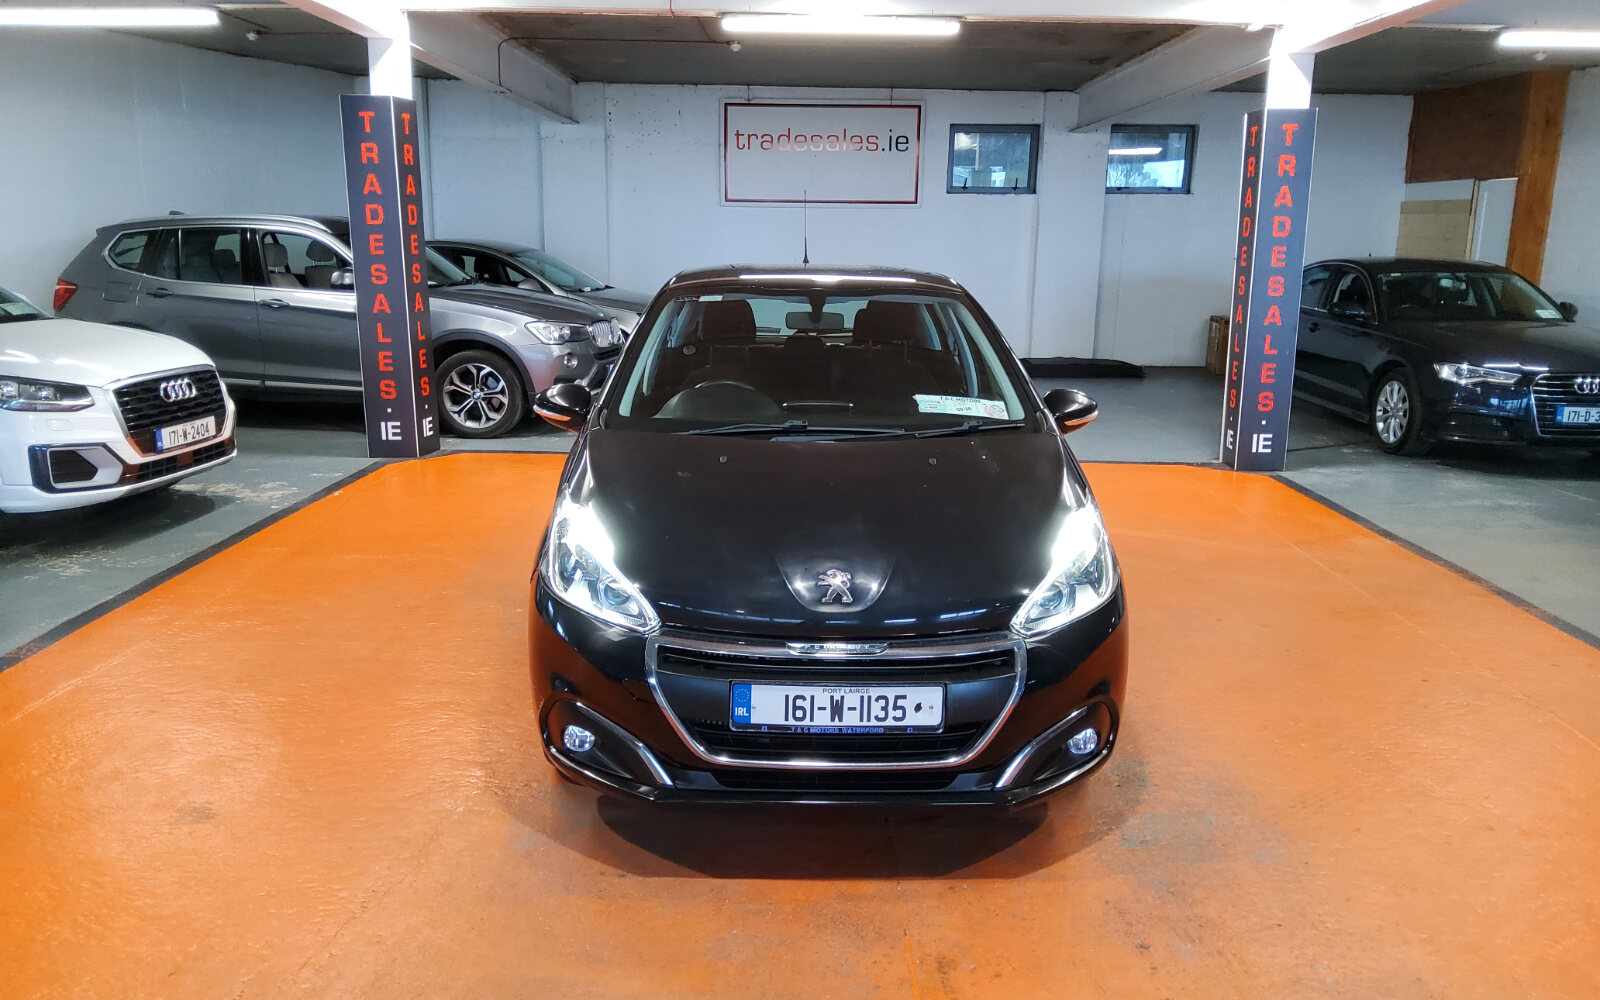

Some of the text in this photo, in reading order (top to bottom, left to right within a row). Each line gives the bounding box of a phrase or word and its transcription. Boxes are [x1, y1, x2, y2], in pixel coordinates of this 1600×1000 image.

[734, 128, 909, 152] tradesales.ie
[169, 422, 209, 445] 171-W-2404
[735, 707, 749, 716] IRL
[784, 694, 908, 723] 161-W-1135
